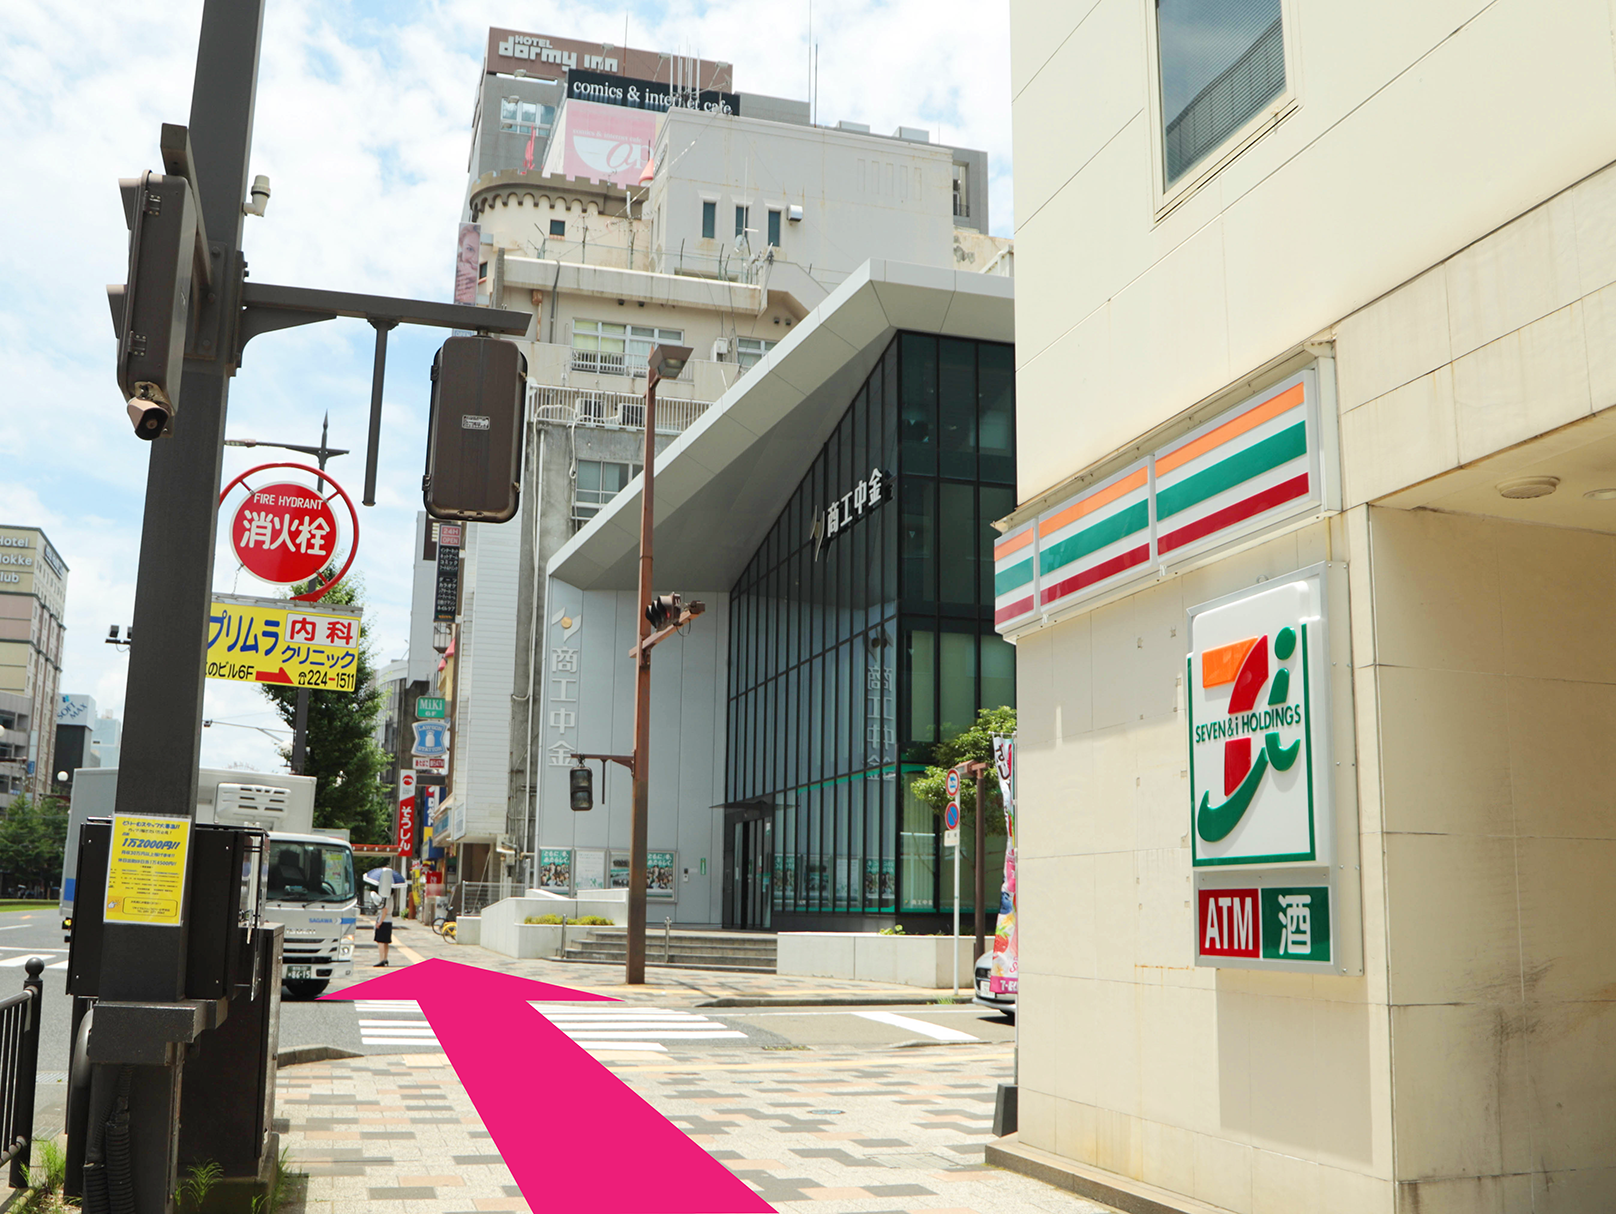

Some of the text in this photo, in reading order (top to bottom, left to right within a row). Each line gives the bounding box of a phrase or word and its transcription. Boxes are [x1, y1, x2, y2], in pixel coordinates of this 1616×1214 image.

[499, 35, 619, 72] dormy inn
[514, 34, 553, 49] HOTEL
[573, 79, 624, 100] comics
[626, 85, 641, 101] &
[703, 99, 733, 115] cafe
[253, 492, 325, 511] FIRE HYDRANT
[826, 467, 883, 538] 商工中金
[239, 509, 331, 556] 消火栓
[0, 571, 20, 583] lub
[208, 610, 353, 657] プリムラ 内科
[281, 645, 356, 669] クリニック
[307, 670, 355, 690] 224-1511
[57, 702, 76, 720] SOFT
[69, 702, 88, 720] MAX
[547, 645, 579, 767] 商工中金
[1241, 703, 1301, 734] HOLDINGS
[400, 805, 412, 851] そうしん
[1204, 894, 1312, 955] ATM 酒
